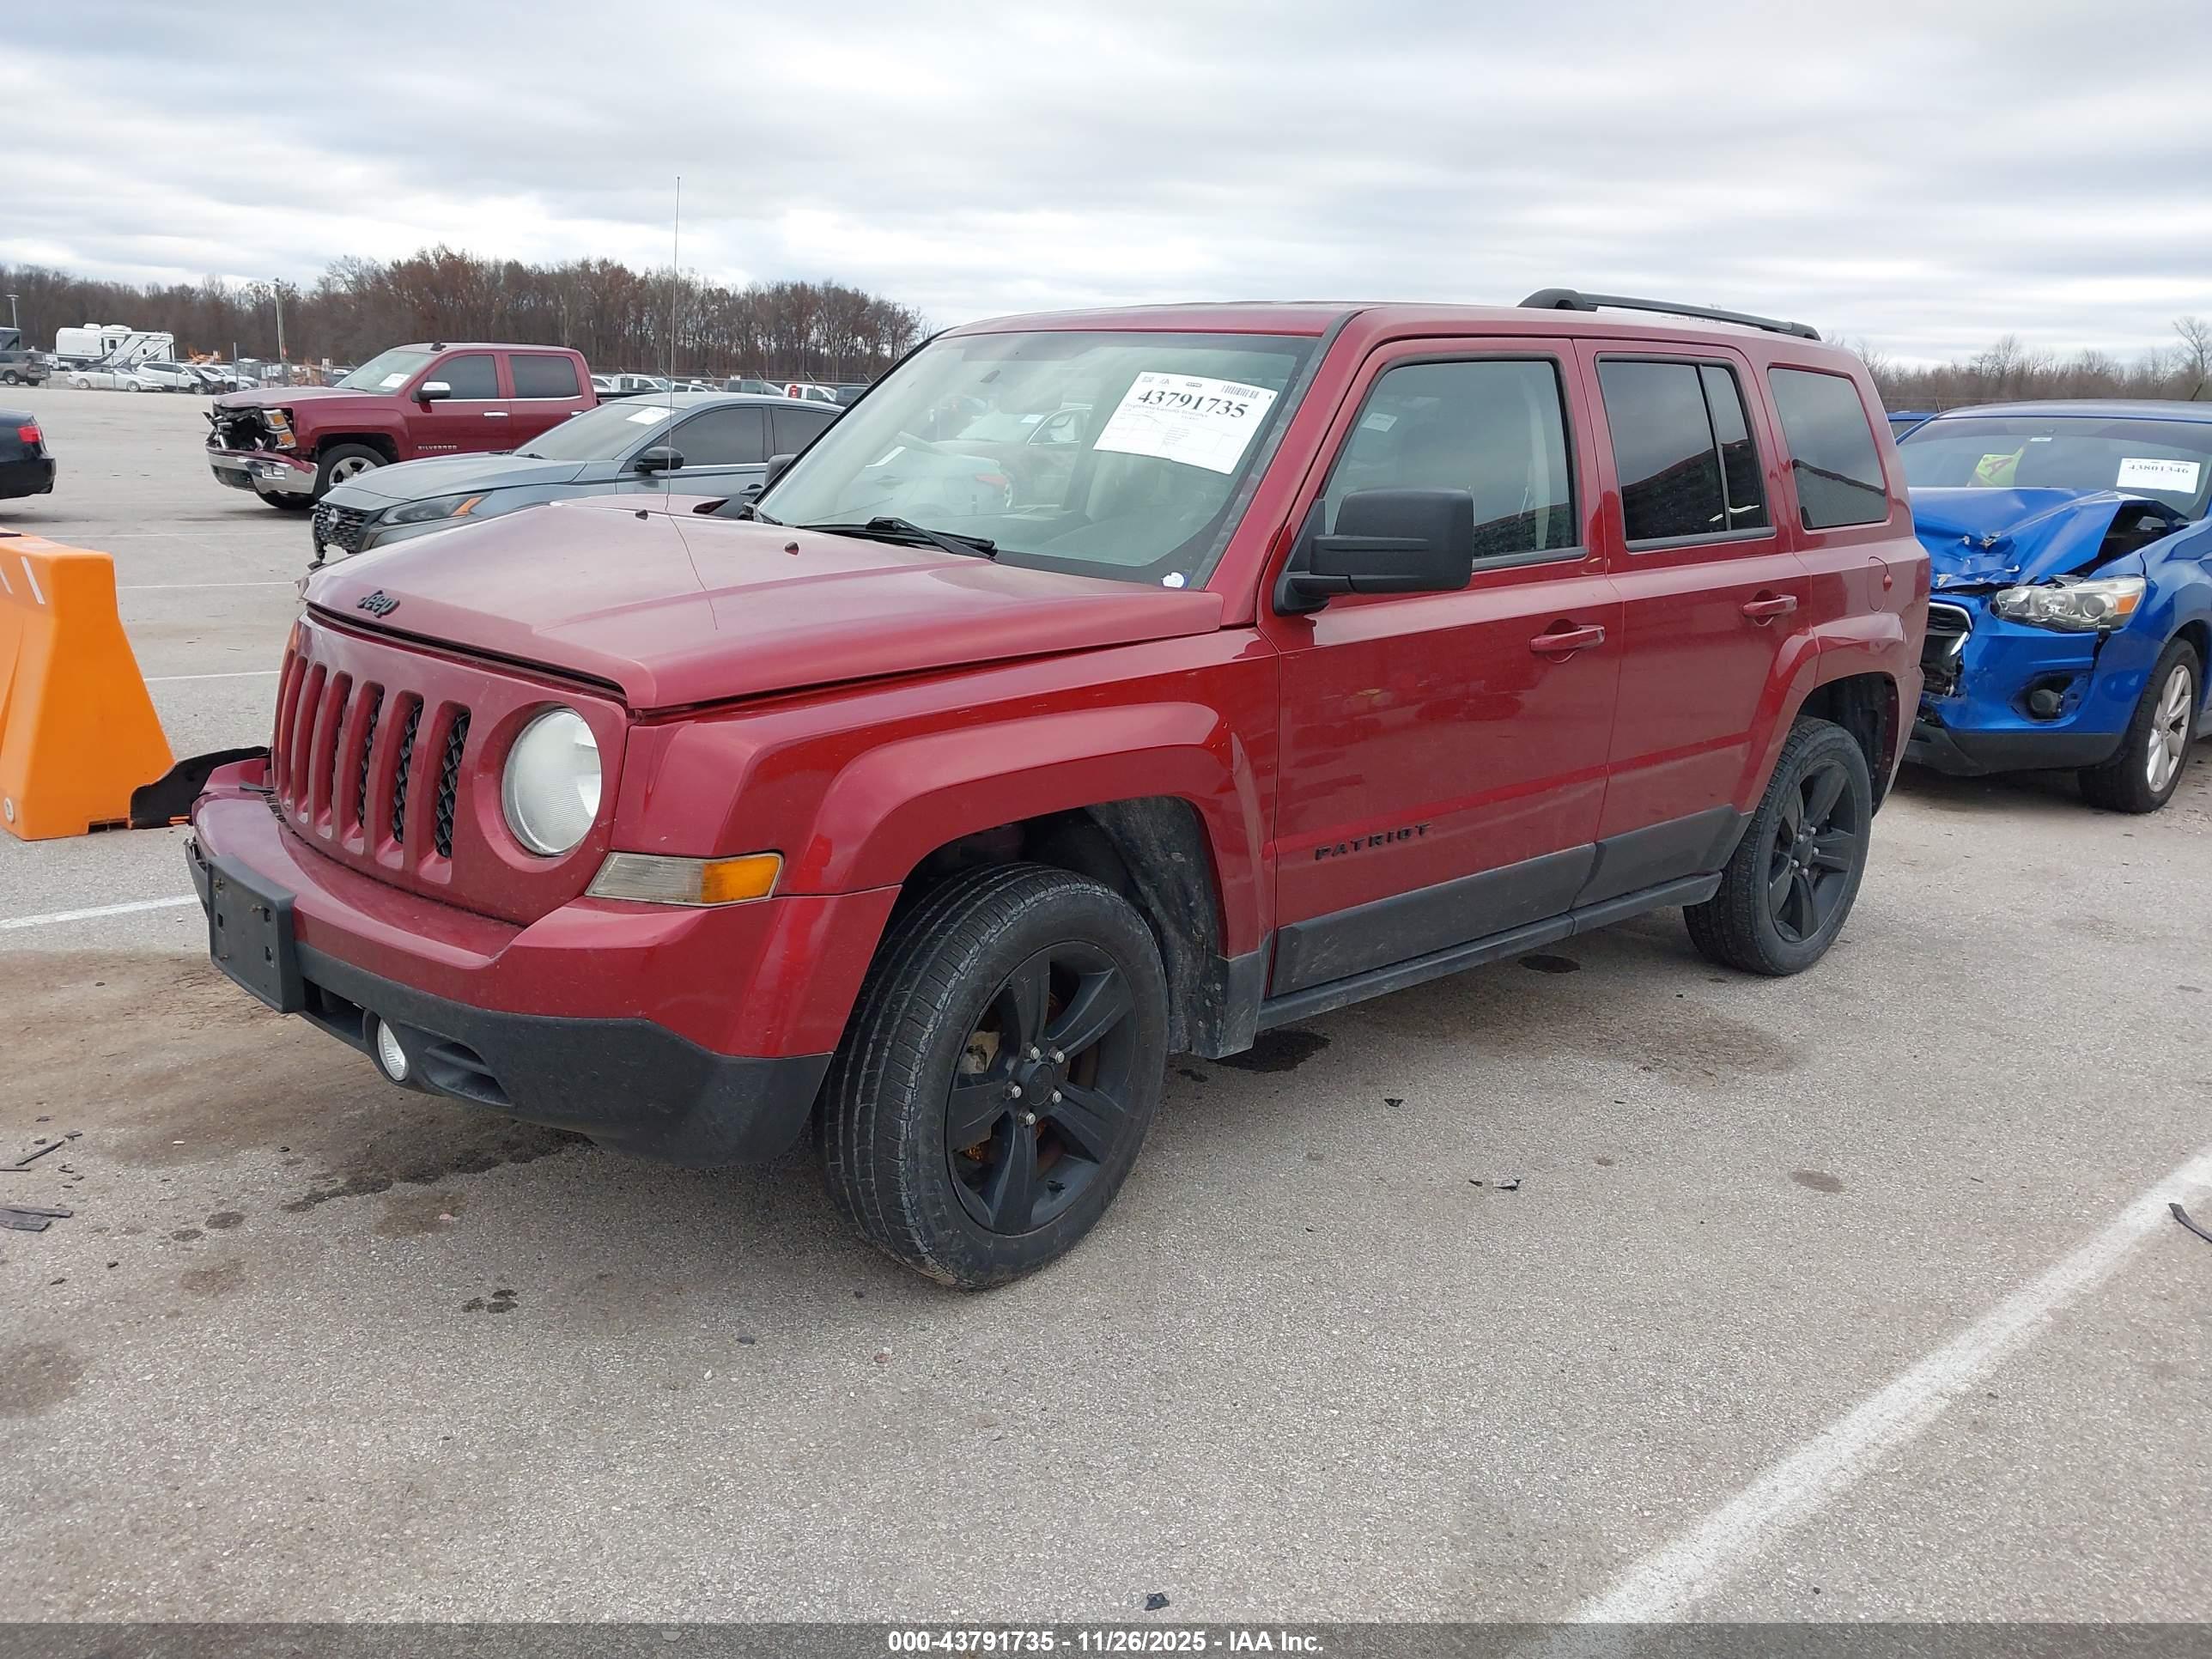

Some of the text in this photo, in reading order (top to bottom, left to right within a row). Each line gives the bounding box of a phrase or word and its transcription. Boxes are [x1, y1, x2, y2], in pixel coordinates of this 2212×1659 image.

[1138, 389, 1249, 418] 43791735
[356, 590, 400, 618] Jeep
[1315, 822, 1432, 860] PATRIOT
